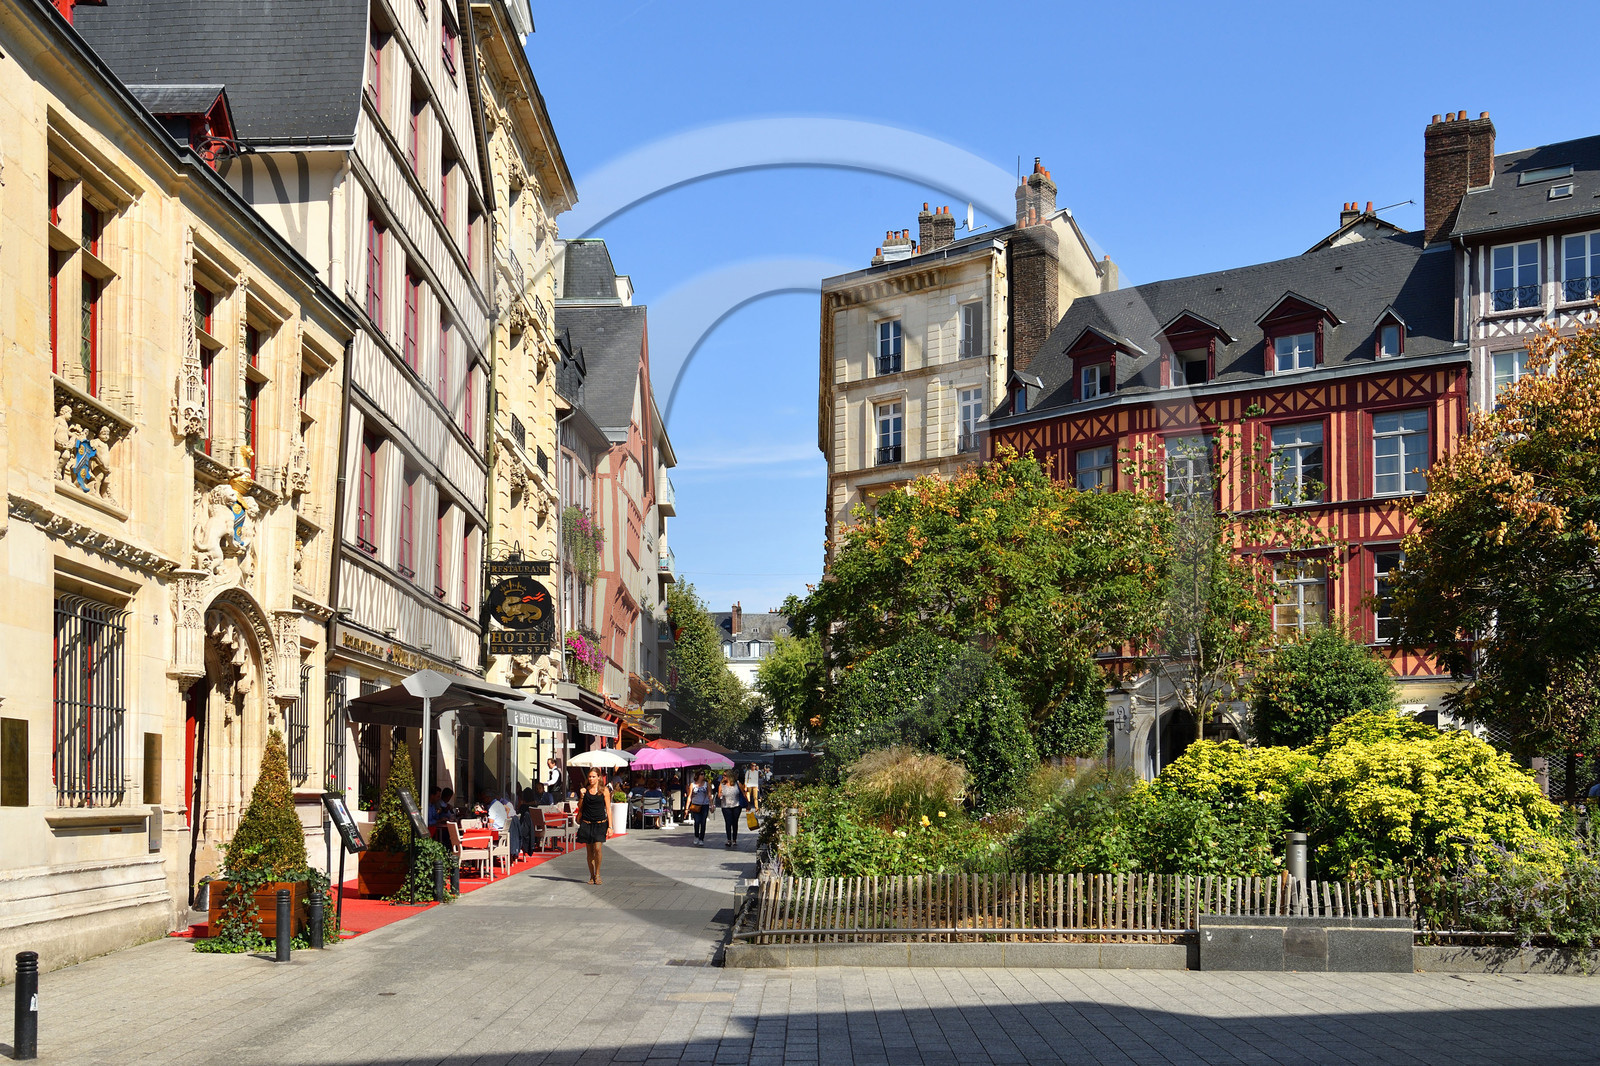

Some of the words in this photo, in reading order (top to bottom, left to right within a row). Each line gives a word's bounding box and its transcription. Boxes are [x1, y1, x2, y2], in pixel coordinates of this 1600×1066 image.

[491, 565, 549, 573] RESTAURANT
[491, 632, 549, 643] HOTEL
[491, 646, 514, 654] BAR
[526, 646, 549, 654] SPA
